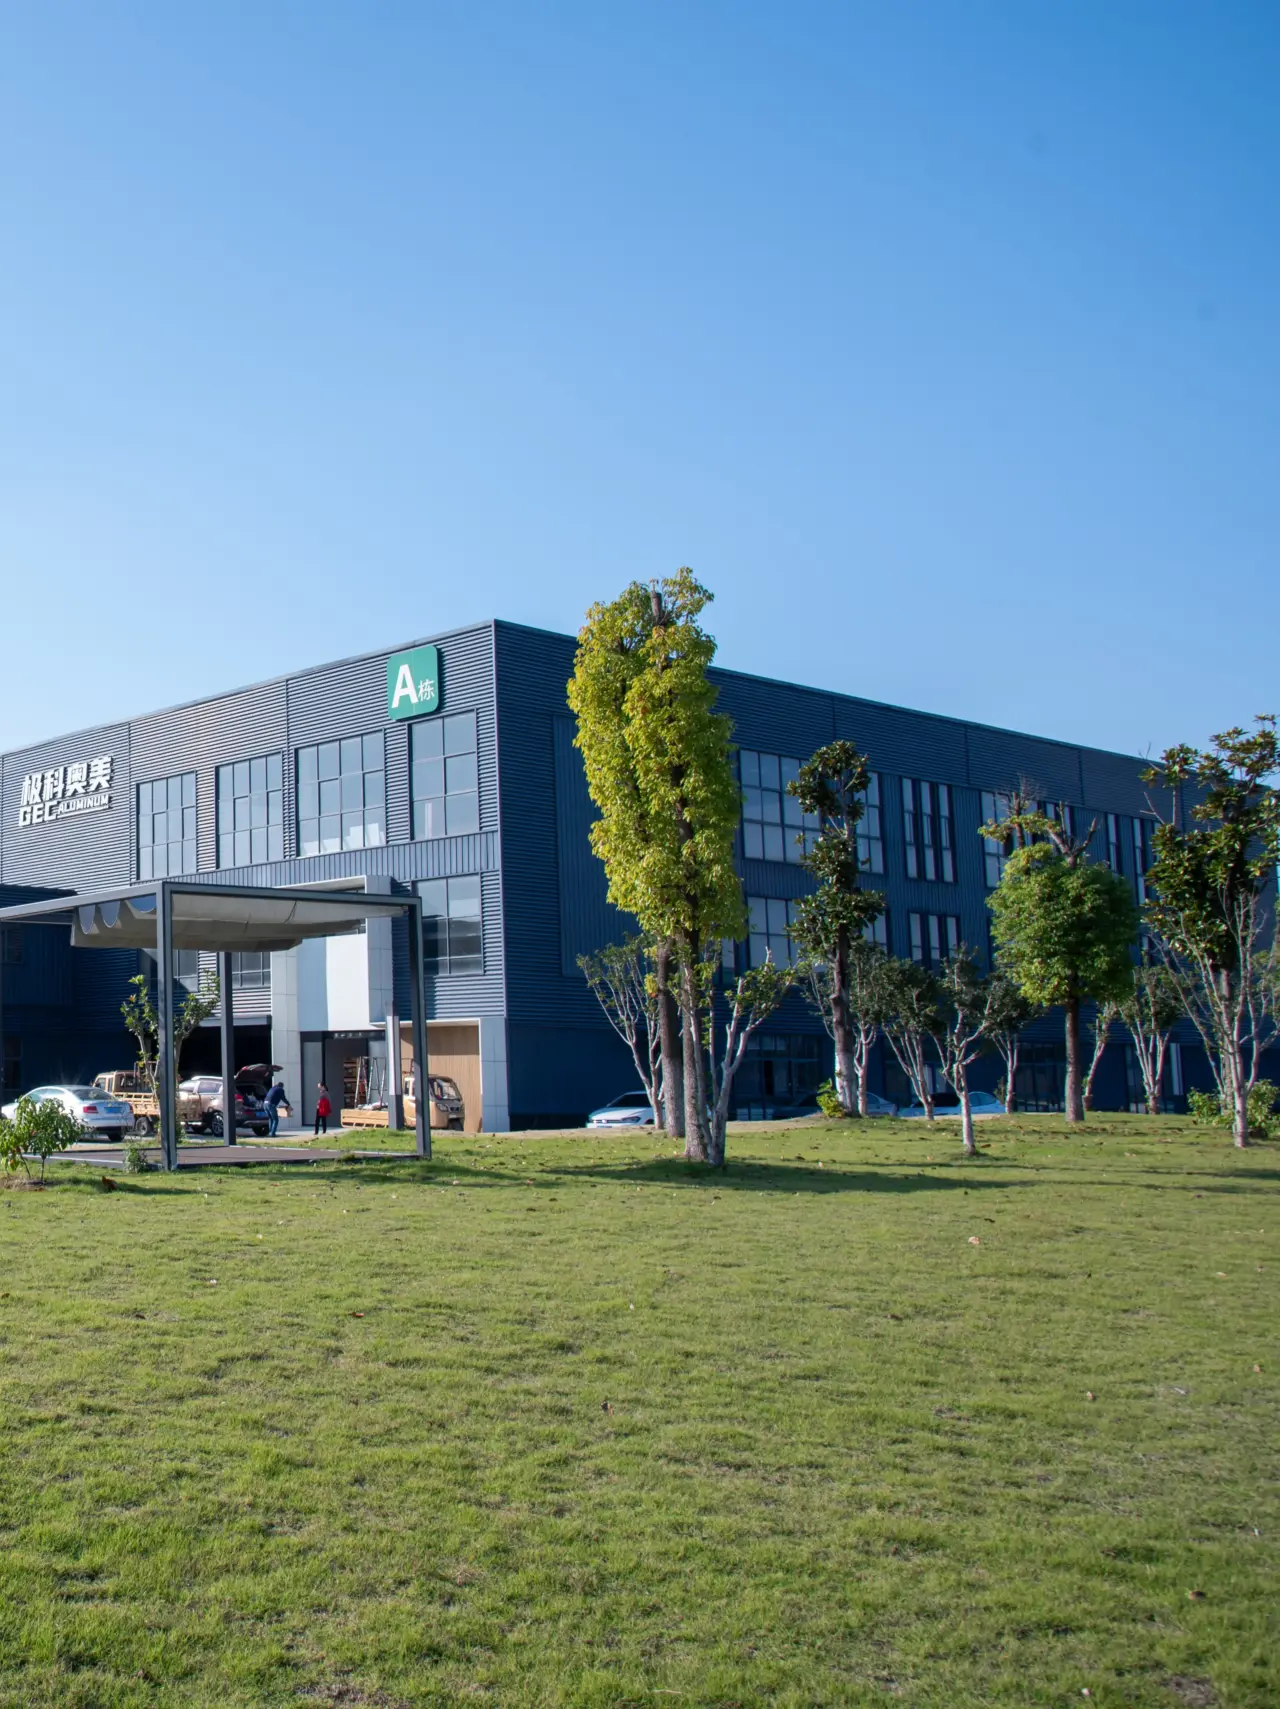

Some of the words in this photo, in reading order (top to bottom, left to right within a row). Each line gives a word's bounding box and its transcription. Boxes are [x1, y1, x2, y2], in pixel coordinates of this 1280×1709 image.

[391, 664, 435, 708] A栋
[21, 755, 112, 806] 极科奥美
[58, 794, 109, 815] ALUMINUM
